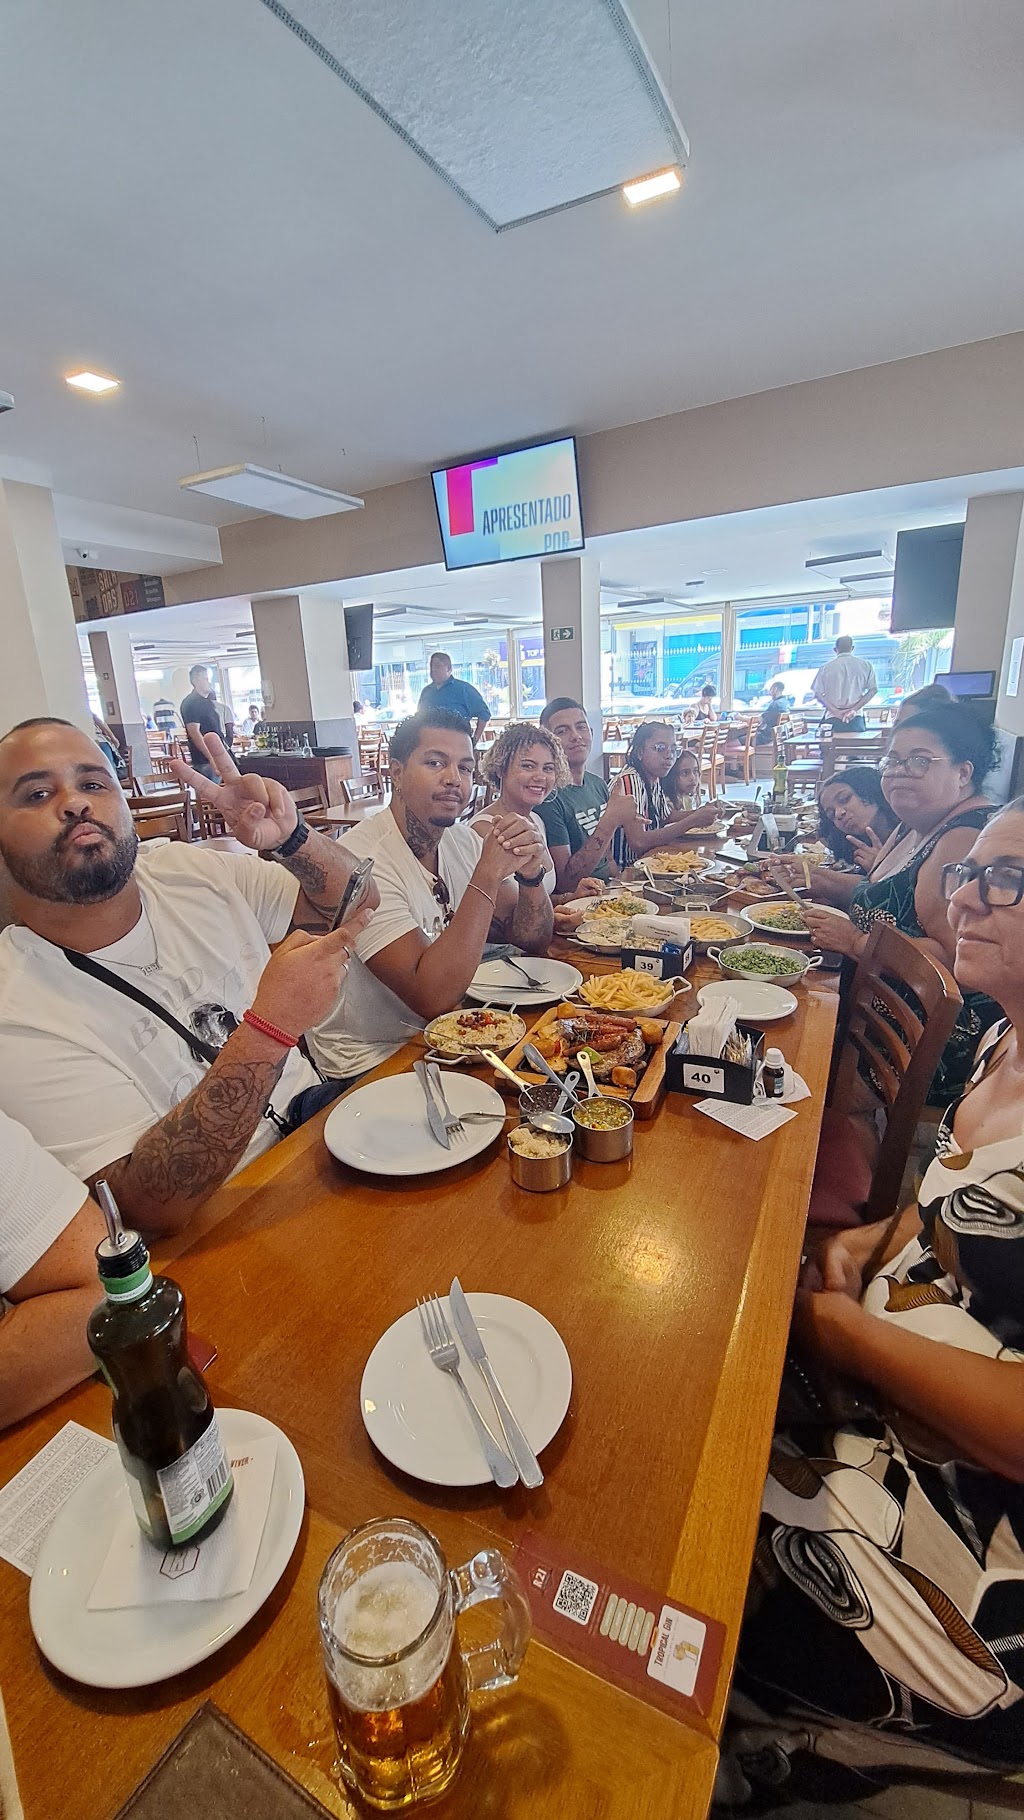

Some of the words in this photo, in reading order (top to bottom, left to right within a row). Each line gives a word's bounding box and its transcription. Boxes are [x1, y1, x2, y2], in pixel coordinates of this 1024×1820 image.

[482, 493, 572, 537] APRESENTADO
[543, 530, 570, 552] POR
[640, 961, 654, 971] 39
[690, 1072, 711, 1084] 40
[653, 1632, 670, 1667] TROPICAL
